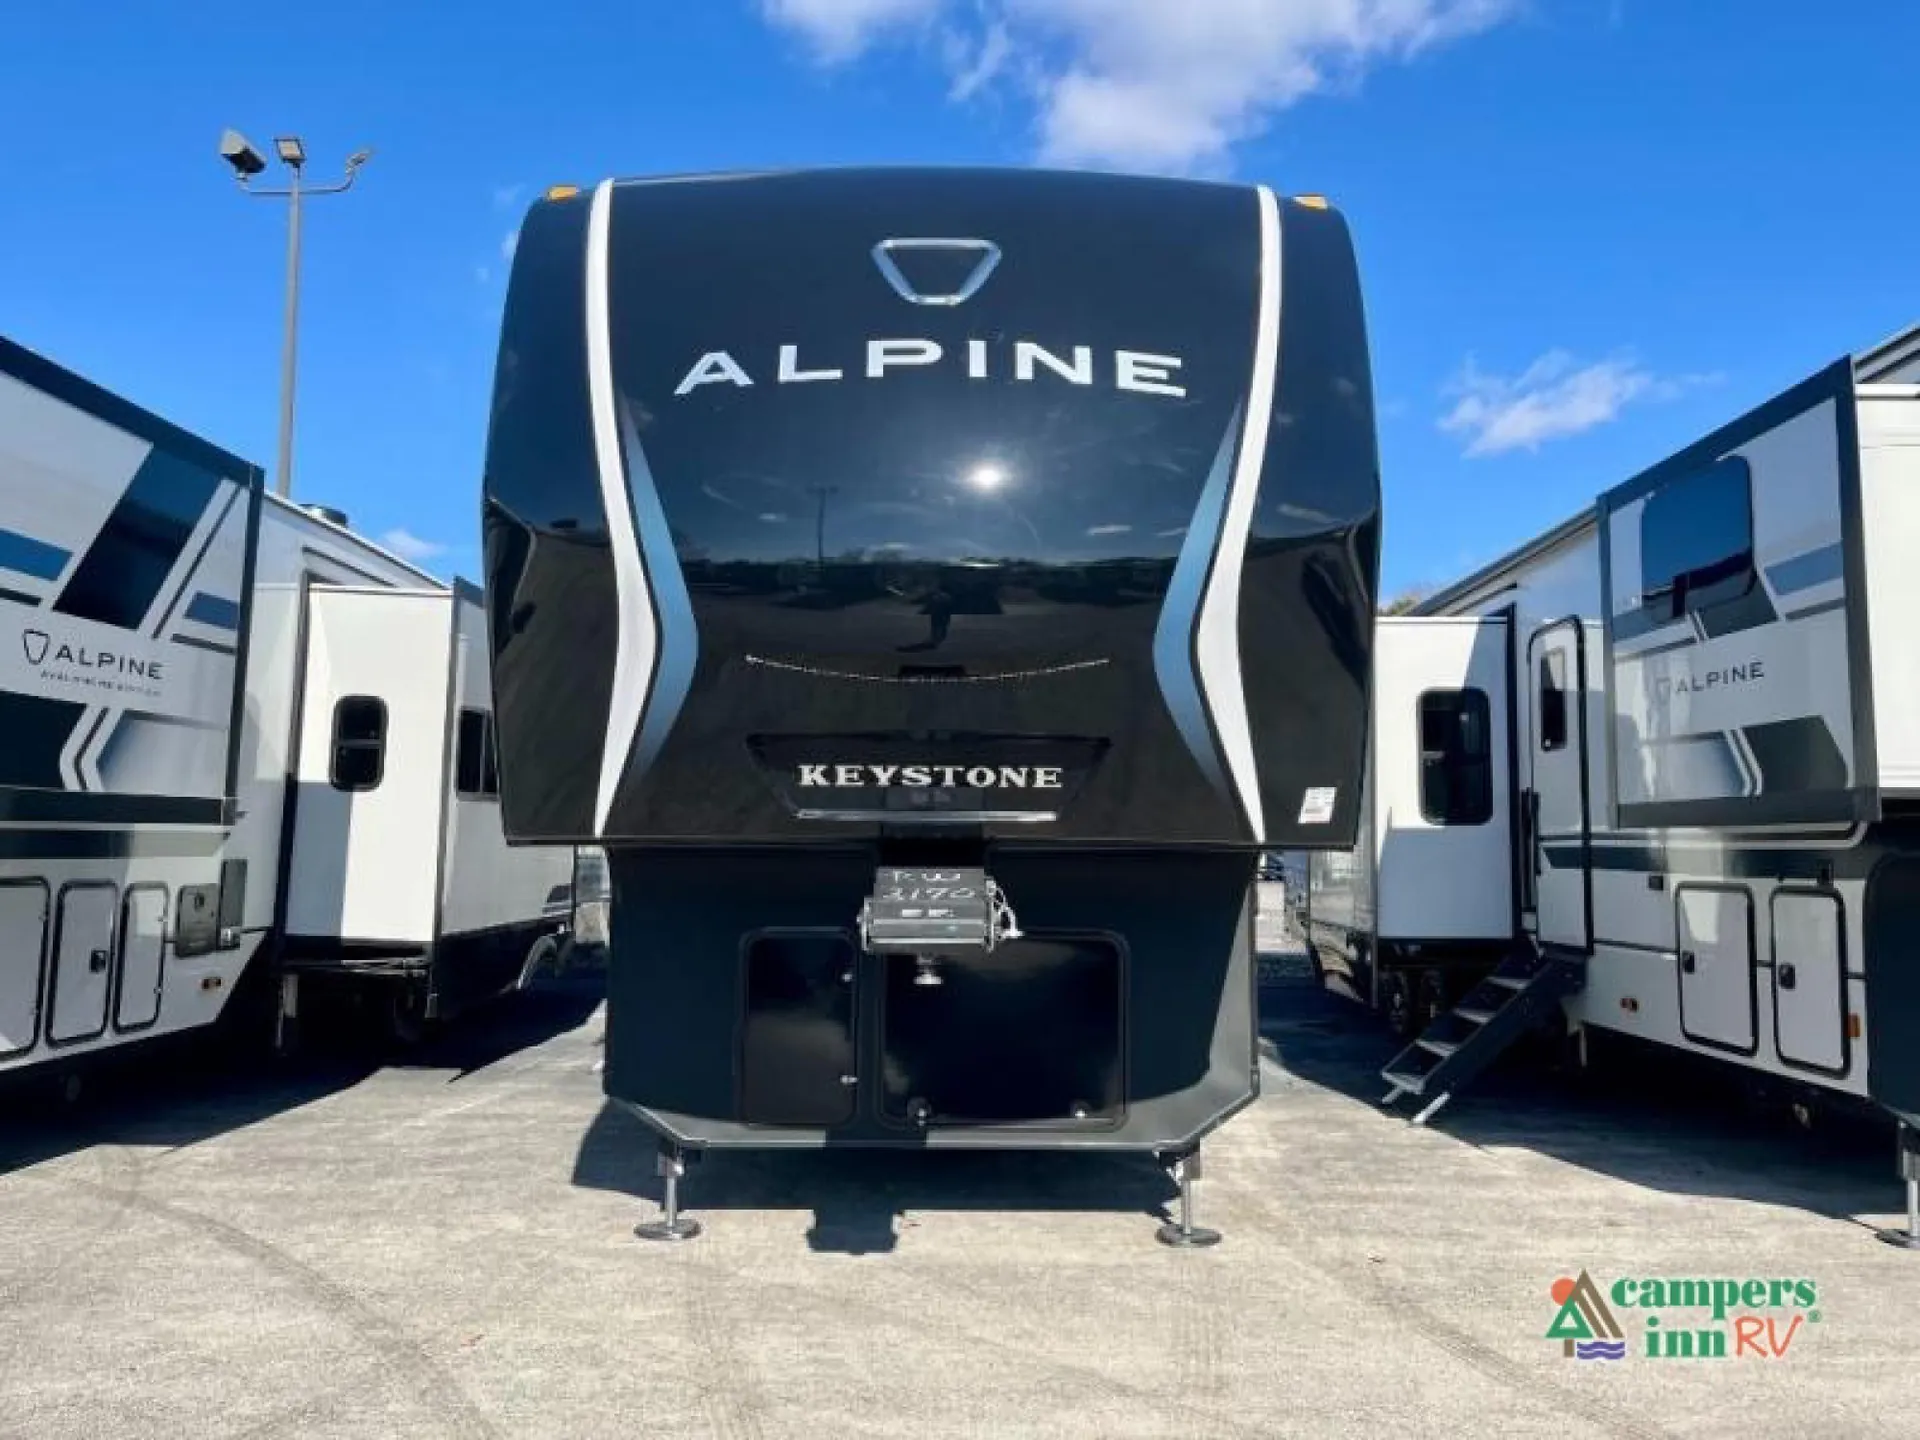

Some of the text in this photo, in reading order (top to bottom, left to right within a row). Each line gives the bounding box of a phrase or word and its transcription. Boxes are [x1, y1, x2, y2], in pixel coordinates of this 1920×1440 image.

[674, 339, 1187, 397] ALPINE
[55, 644, 163, 680] ALPINE
[1676, 661, 1765, 692] ALPINE
[797, 764, 1063, 788] KEYSTONE
